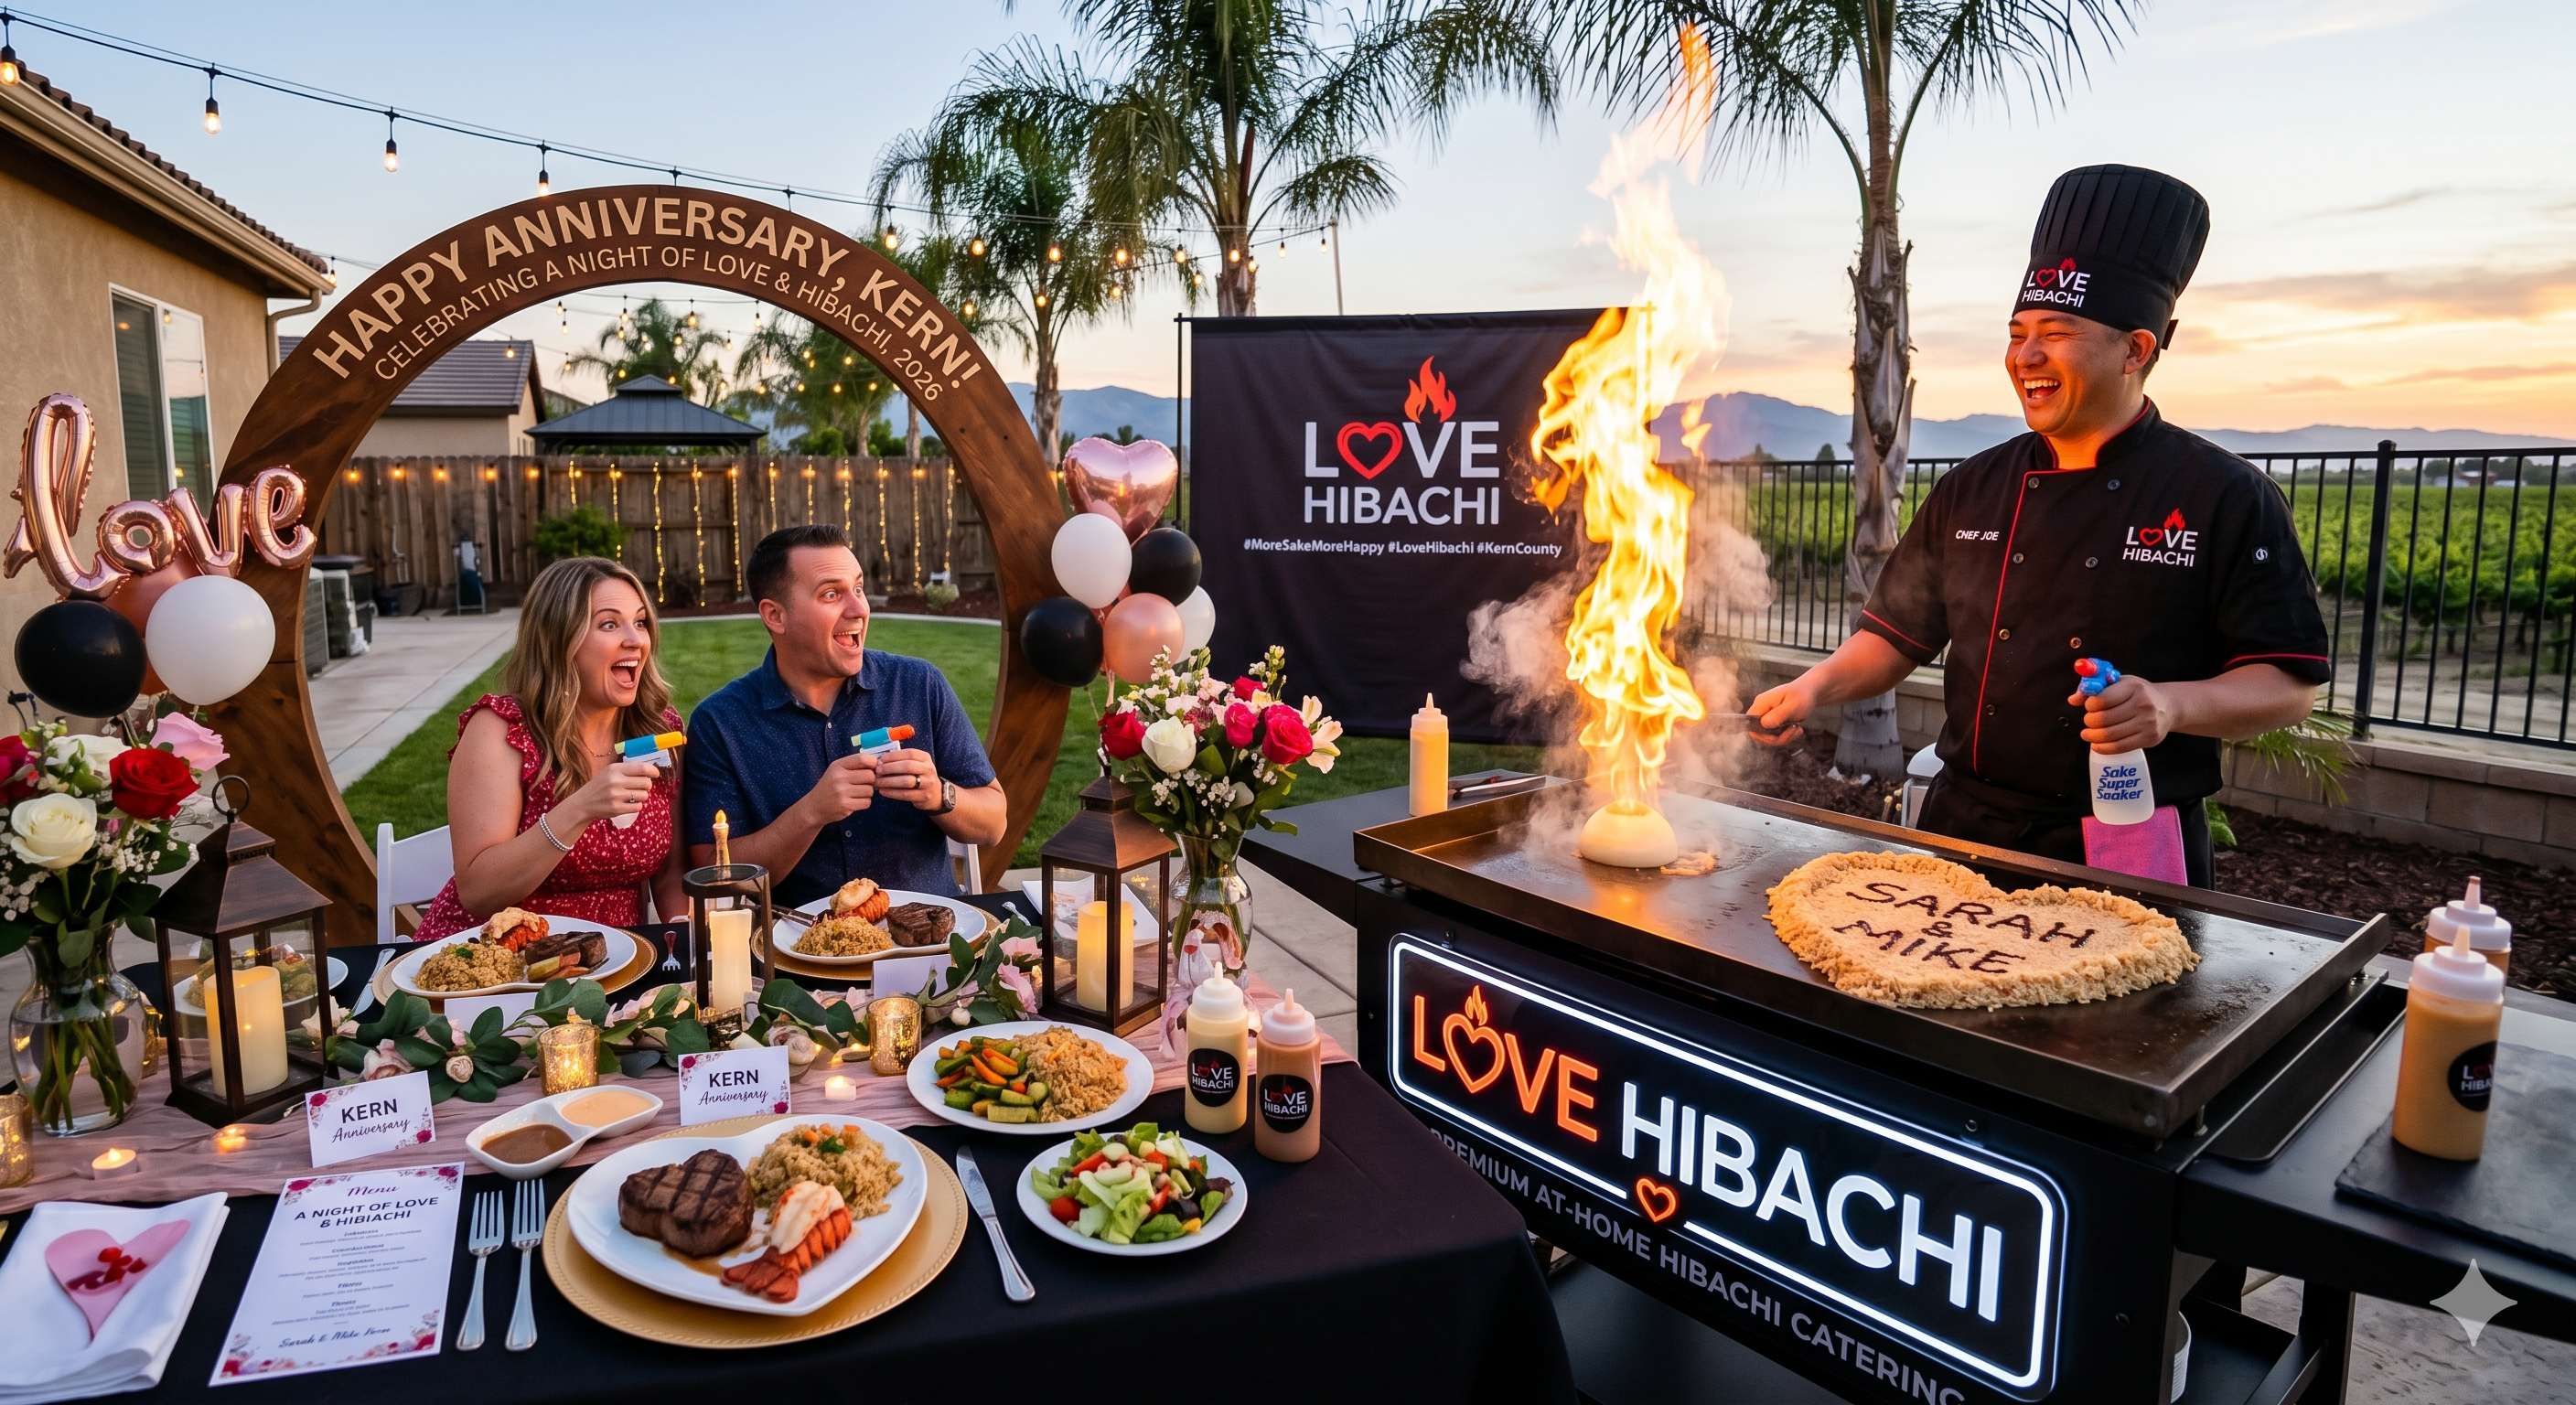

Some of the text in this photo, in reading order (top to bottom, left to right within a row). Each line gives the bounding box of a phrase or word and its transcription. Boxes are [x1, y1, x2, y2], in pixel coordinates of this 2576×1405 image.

[2026, 268, 2091, 293] LOVE
[313, 197, 982, 389] HAPPY ANNIVERSARY, KERN!
[2022, 289, 2085, 307] HIBACHI
[374, 246, 943, 401] CELEBRATING A NIGHT OF LOVE & HIBACHI, 2026
[1304, 421, 1500, 480] LOVE
[1304, 486, 1500, 525] HIBACHI
[1243, 538, 1562, 558] #MoreSakeMoreHappy #LoveHibachi #KernCounty
[1980, 531, 2000, 541] JOE
[2126, 526, 2198, 551] LOVE
[2122, 548, 2195, 567] HIBACHI
[2098, 778, 2141, 790] Super
[2101, 766, 2137, 778] Sake
[1846, 883, 2096, 949] SARAH
[1922, 917, 1954, 938] &
[1832, 920, 2026, 974] MIKE
[709, 1069, 759, 1088] KERN
[698, 1090, 769, 1106] Anniversary
[1264, 1101, 1307, 1114] HIBACHI
[341, 1099, 398, 1123] KERN
[332, 1119, 411, 1143] Anniversary
[1413, 994, 2003, 1324] LOVE HIBACHI
[347, 1185, 400, 1197] Menu
[294, 1196, 439, 1221] A NIGHT OF LOVE
[320, 1210, 412, 1228] & HIBIACHI
[1535, 1184, 1651, 1261] AT-HOME
[1659, 1244, 1781, 1327] HIBACHI
